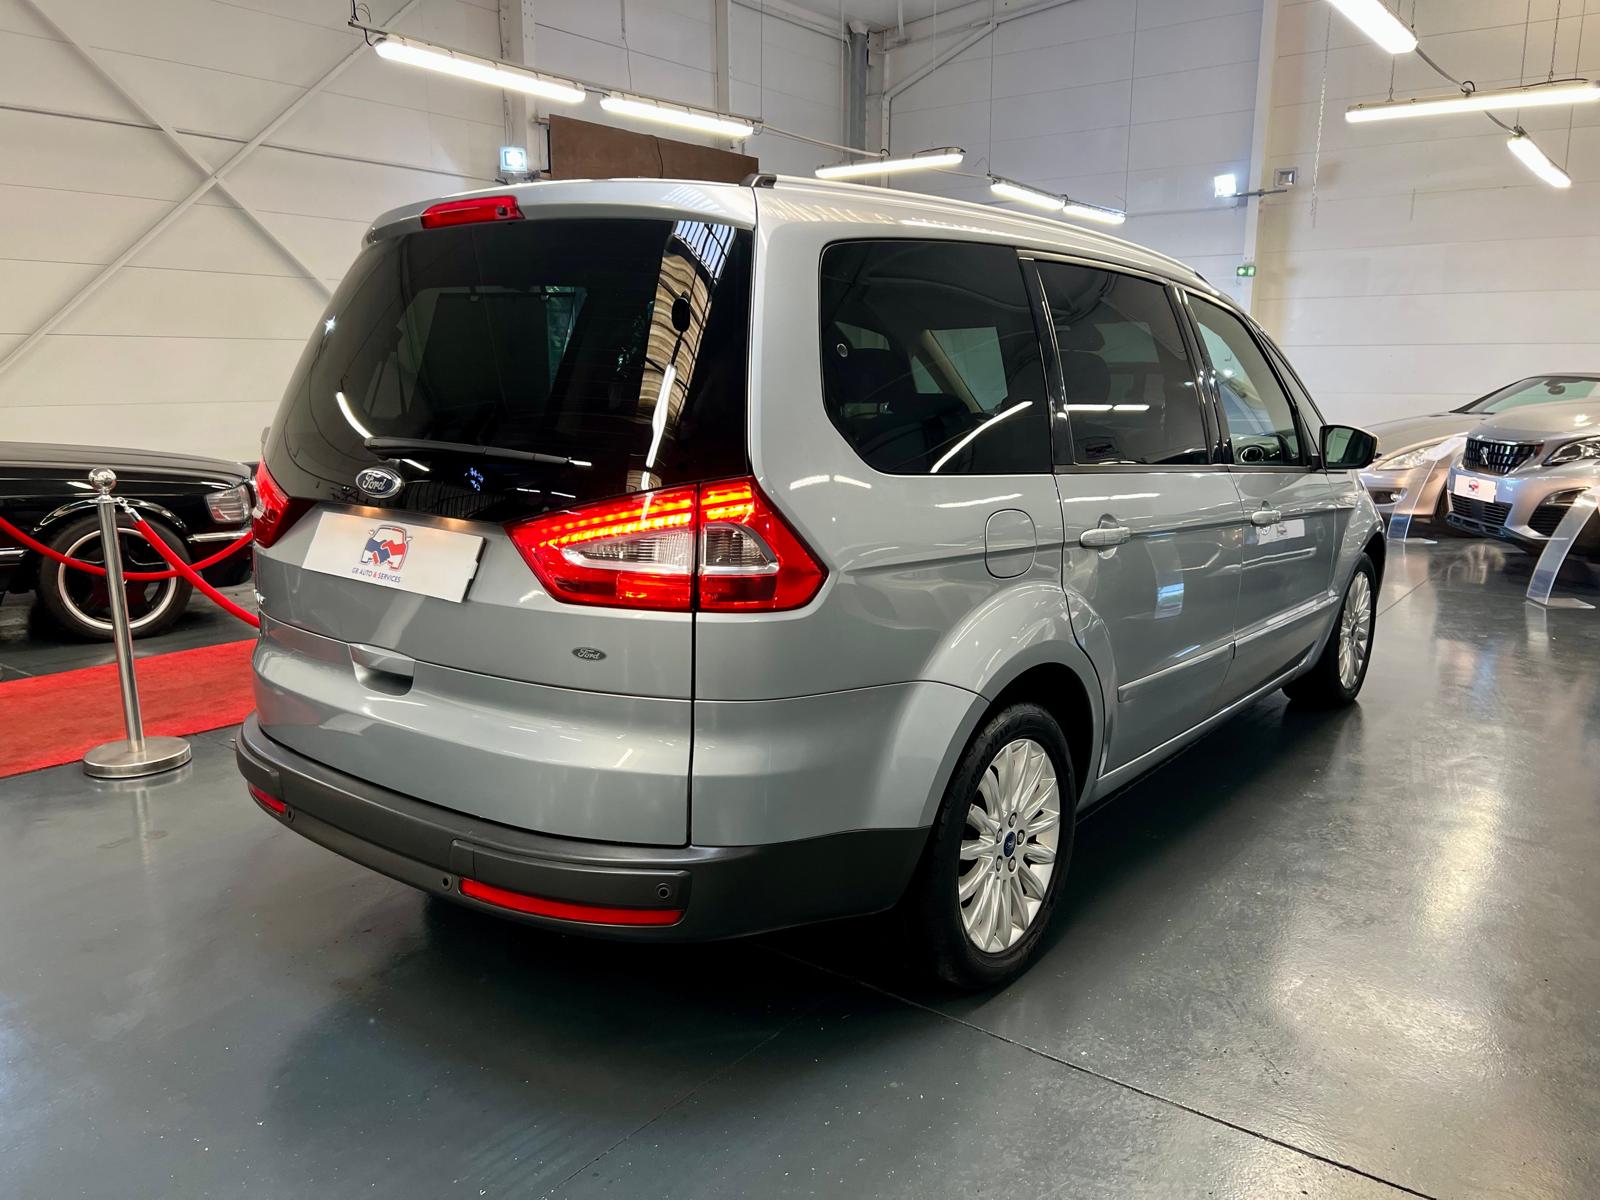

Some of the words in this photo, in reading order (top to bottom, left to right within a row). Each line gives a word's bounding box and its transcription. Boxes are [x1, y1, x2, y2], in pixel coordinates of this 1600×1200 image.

[362, 472, 387, 491] Ford
[360, 569, 373, 577] AUTO
[378, 571, 401, 583] SERVICES
[577, 648, 600, 659] Ford
